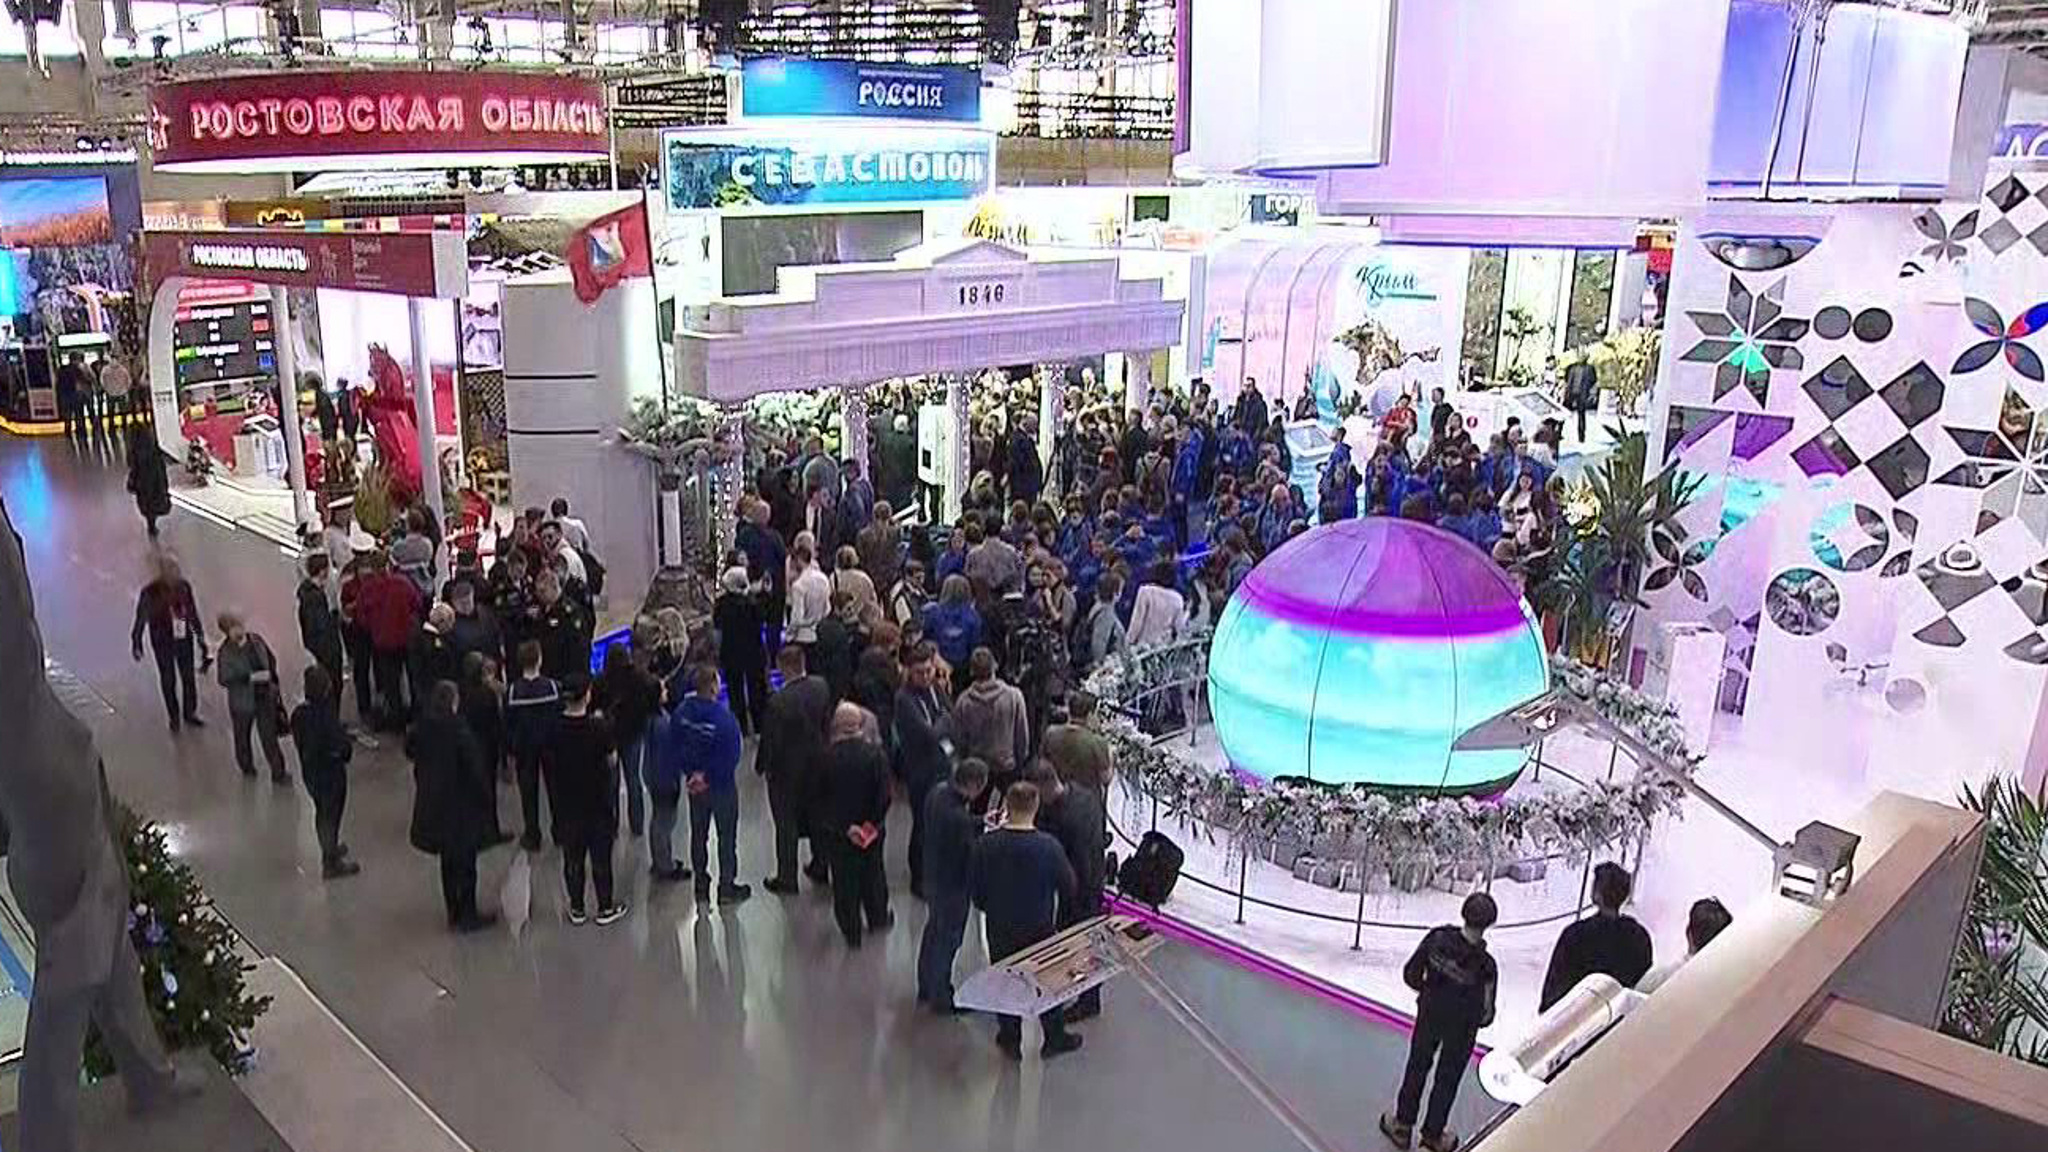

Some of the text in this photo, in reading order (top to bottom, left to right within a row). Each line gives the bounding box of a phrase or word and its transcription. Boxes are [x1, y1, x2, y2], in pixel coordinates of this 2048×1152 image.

[858, 80, 943, 108] РОССИЯ
[190, 94, 604, 139] РОСТОВСКАЯ ОБЛАСТЬ
[191, 243, 308, 272] РОСТОВСКАЯ ОБЛАСТЬ
